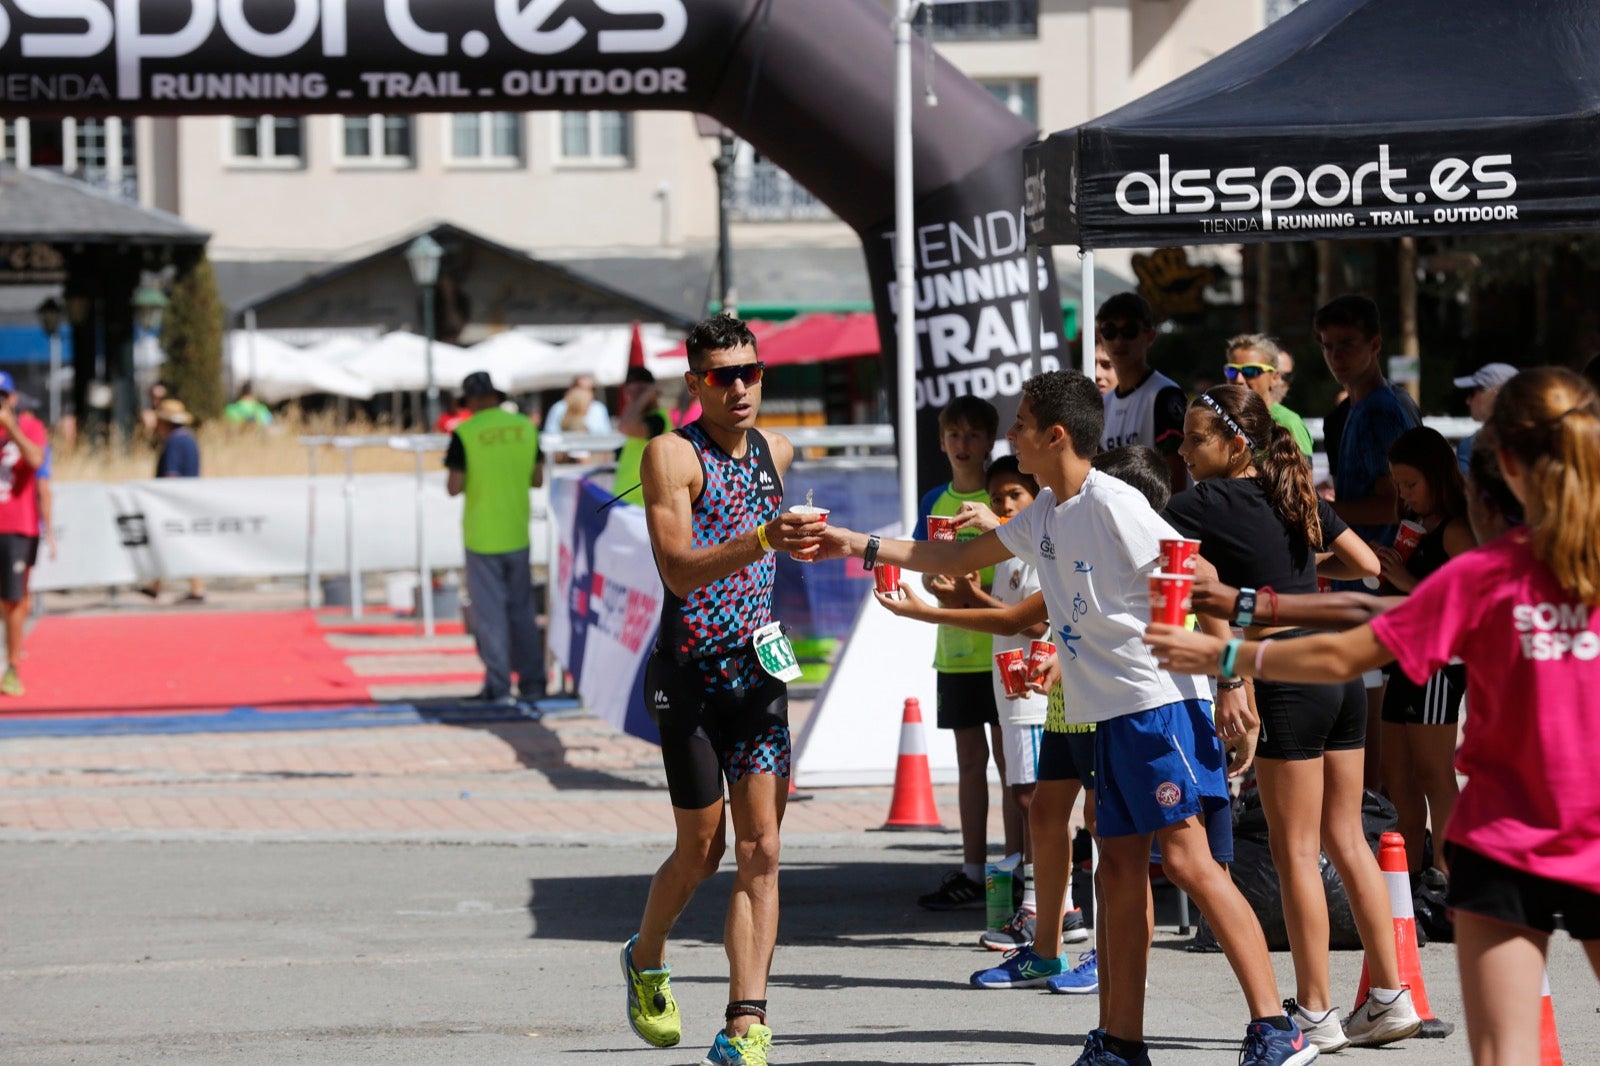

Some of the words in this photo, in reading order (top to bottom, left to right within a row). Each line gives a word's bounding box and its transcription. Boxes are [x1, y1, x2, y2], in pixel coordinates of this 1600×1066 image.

[152, 72, 328, 99] RUNNING
[361, 71, 471, 97] TRAIL
[502, 67, 687, 96] OUTDOOR
[1115, 144, 1517, 230] alssport.es
[1200, 216, 1259, 233] TIENDA
[1277, 212, 1355, 230] RUNNING
[1370, 210, 1419, 226] TRAIL
[1433, 204, 1519, 224] OUTDOOR
